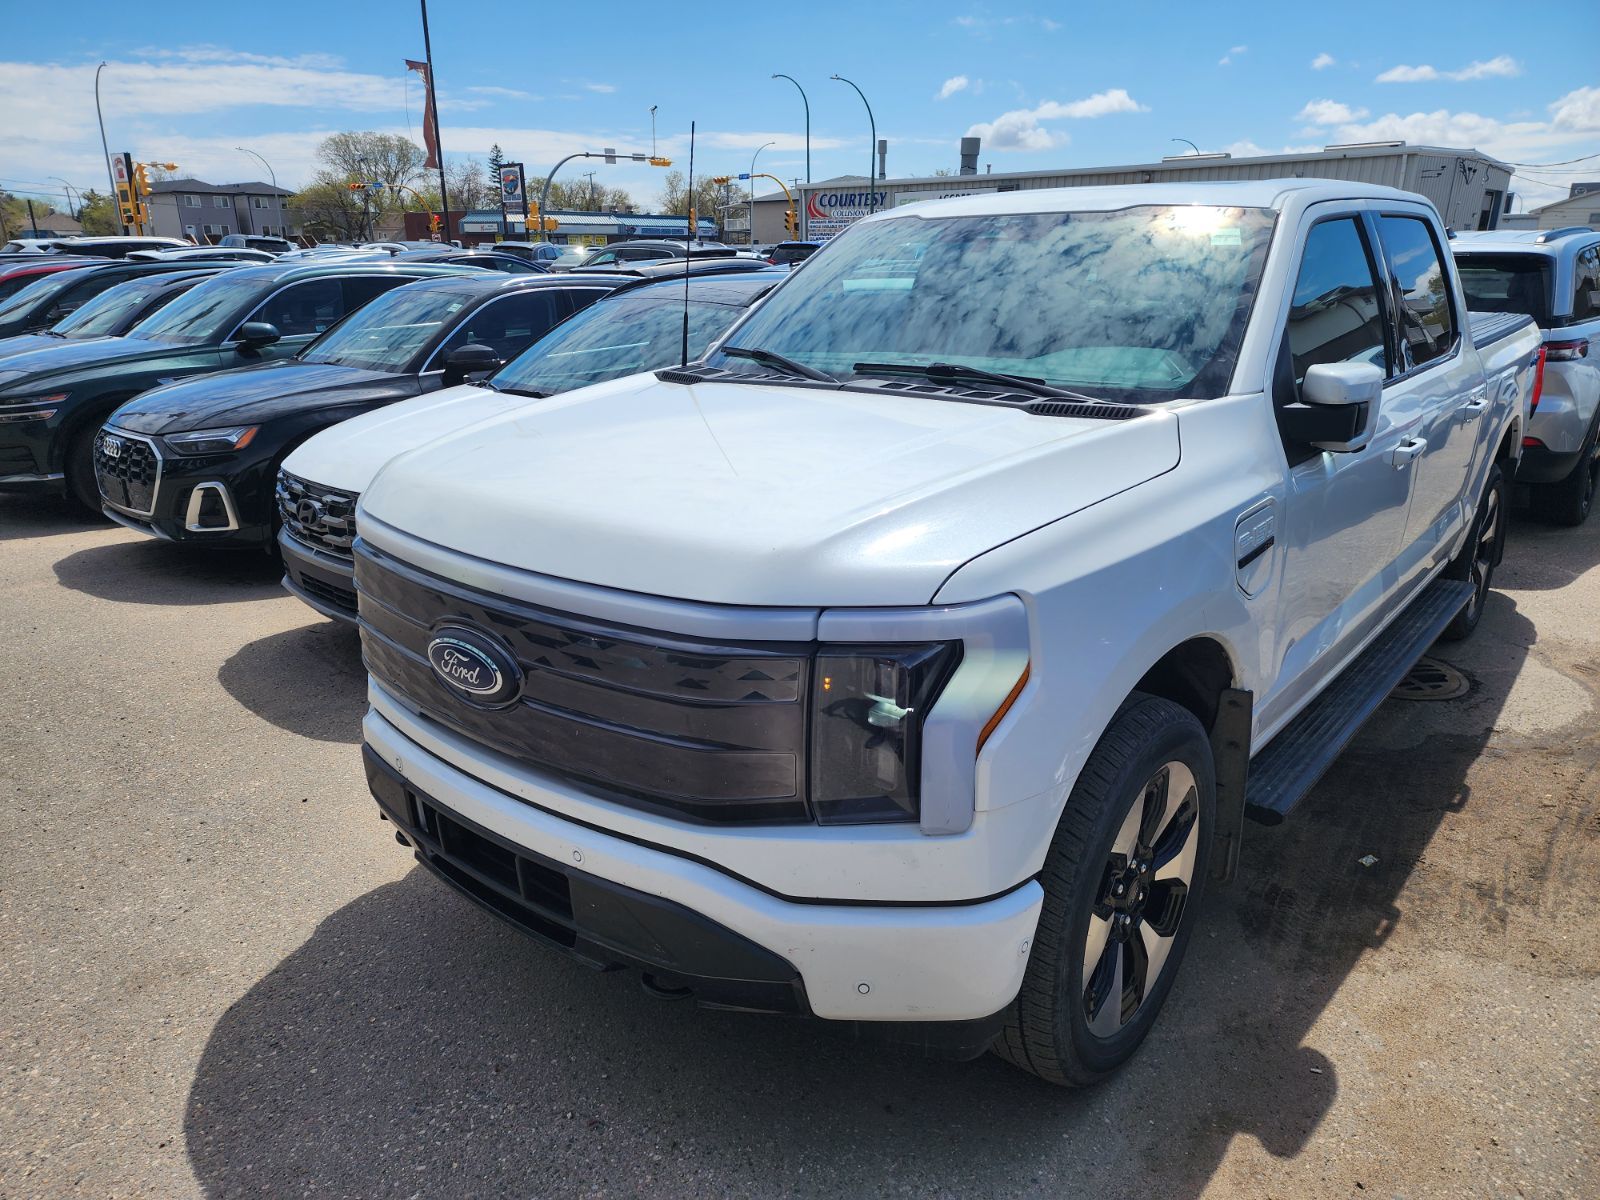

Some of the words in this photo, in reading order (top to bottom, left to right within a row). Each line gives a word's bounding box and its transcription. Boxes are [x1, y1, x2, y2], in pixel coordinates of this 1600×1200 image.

[819, 191, 888, 208] COURTESY
[832, 209, 866, 218] COLLISION
[441, 649, 480, 684] Ford
